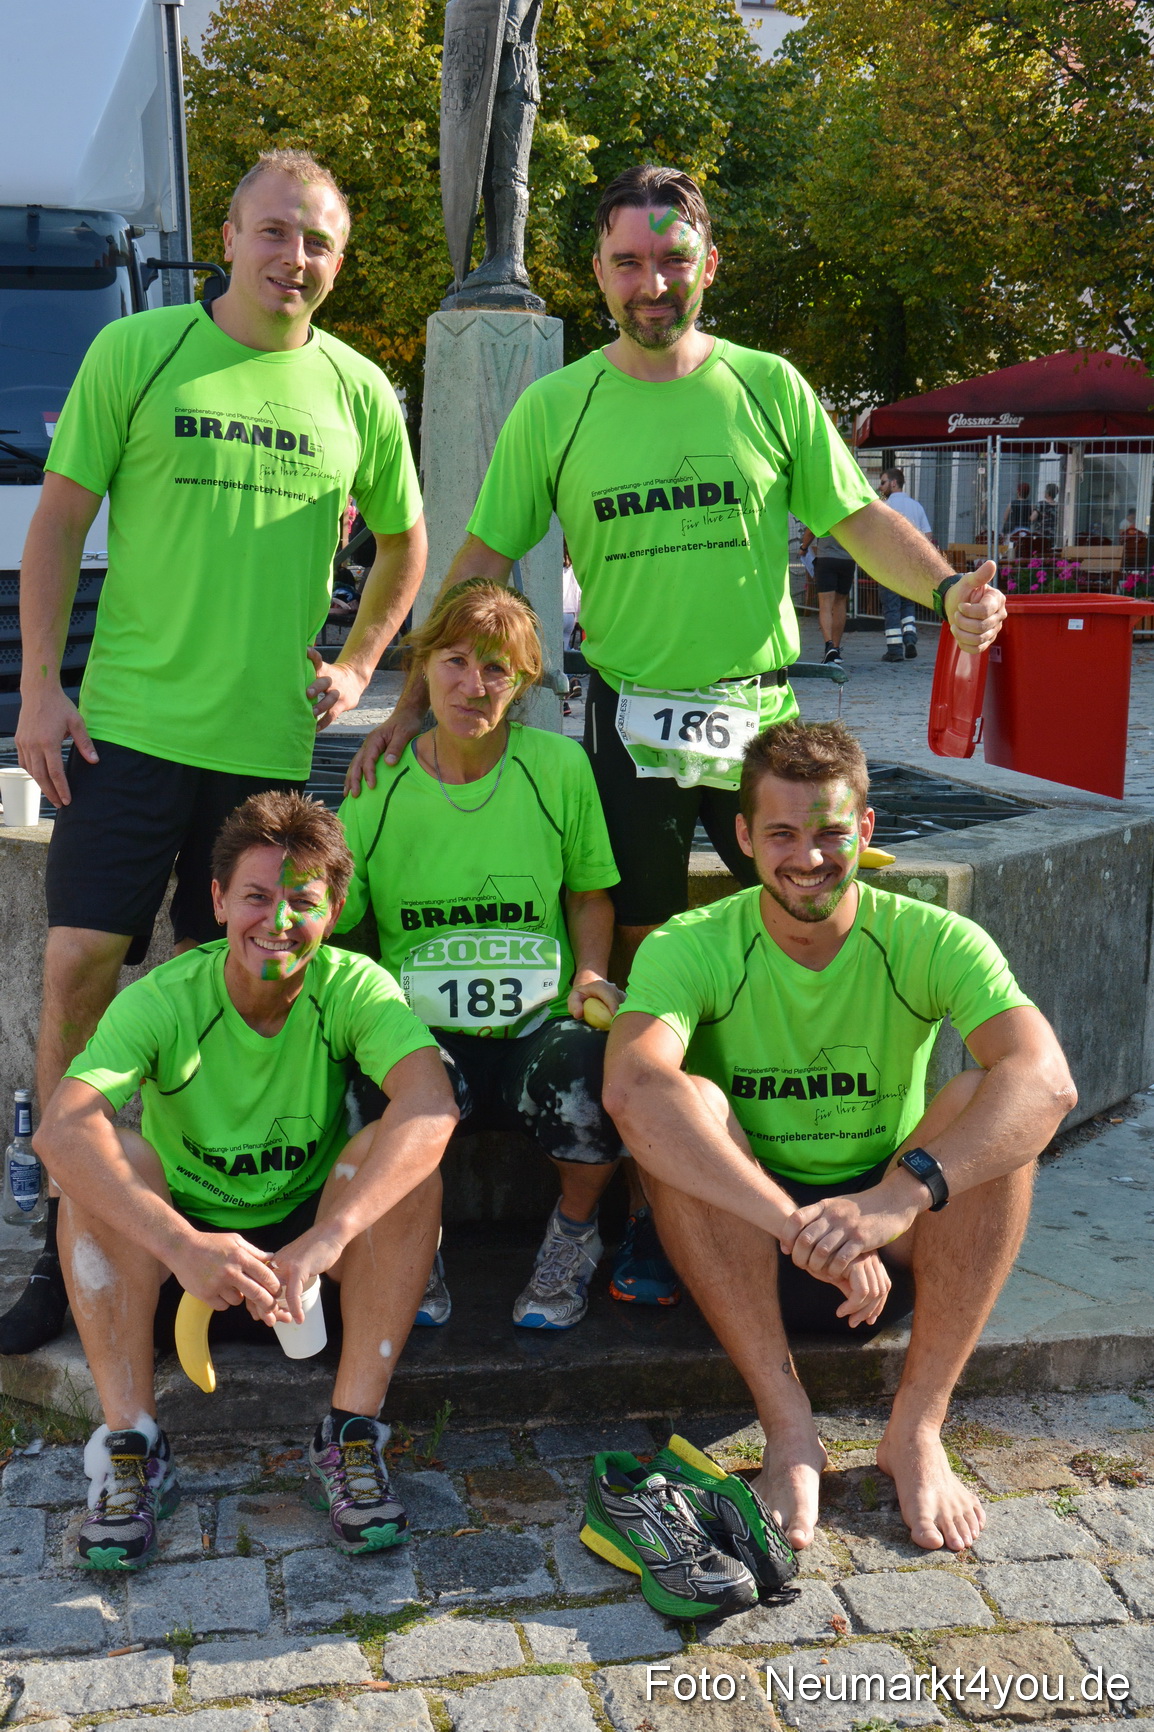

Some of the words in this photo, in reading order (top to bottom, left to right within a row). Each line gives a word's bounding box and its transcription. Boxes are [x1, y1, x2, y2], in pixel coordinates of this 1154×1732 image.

[174, 415, 315, 457] BRANDL
[947, 413, 1024, 433] Glossner-Bier
[259, 464, 275, 480] für
[281, 467, 298, 477] Ihre
[174, 477, 318, 505] www.energieberater-brandl.de
[591, 482, 642, 498] Energieberatungs-
[643, 479, 654, 487] und
[655, 475, 693, 485] Planungsbüro
[593, 481, 742, 523] BRANDL
[681, 519, 699, 536] für
[703, 511, 723, 525] Ihre
[605, 538, 751, 562] www.energieberater-brandl.de
[653, 708, 731, 749] 186
[746, 720, 755, 729] E6
[400, 900, 540, 931] BRANDL
[413, 935, 546, 967] BOCK
[438, 977, 523, 1018] 183
[730, 1072, 877, 1100] BRANDL
[814, 1109, 832, 1126] für
[836, 1101, 857, 1115] Ihre
[230, 1145, 242, 1153] und
